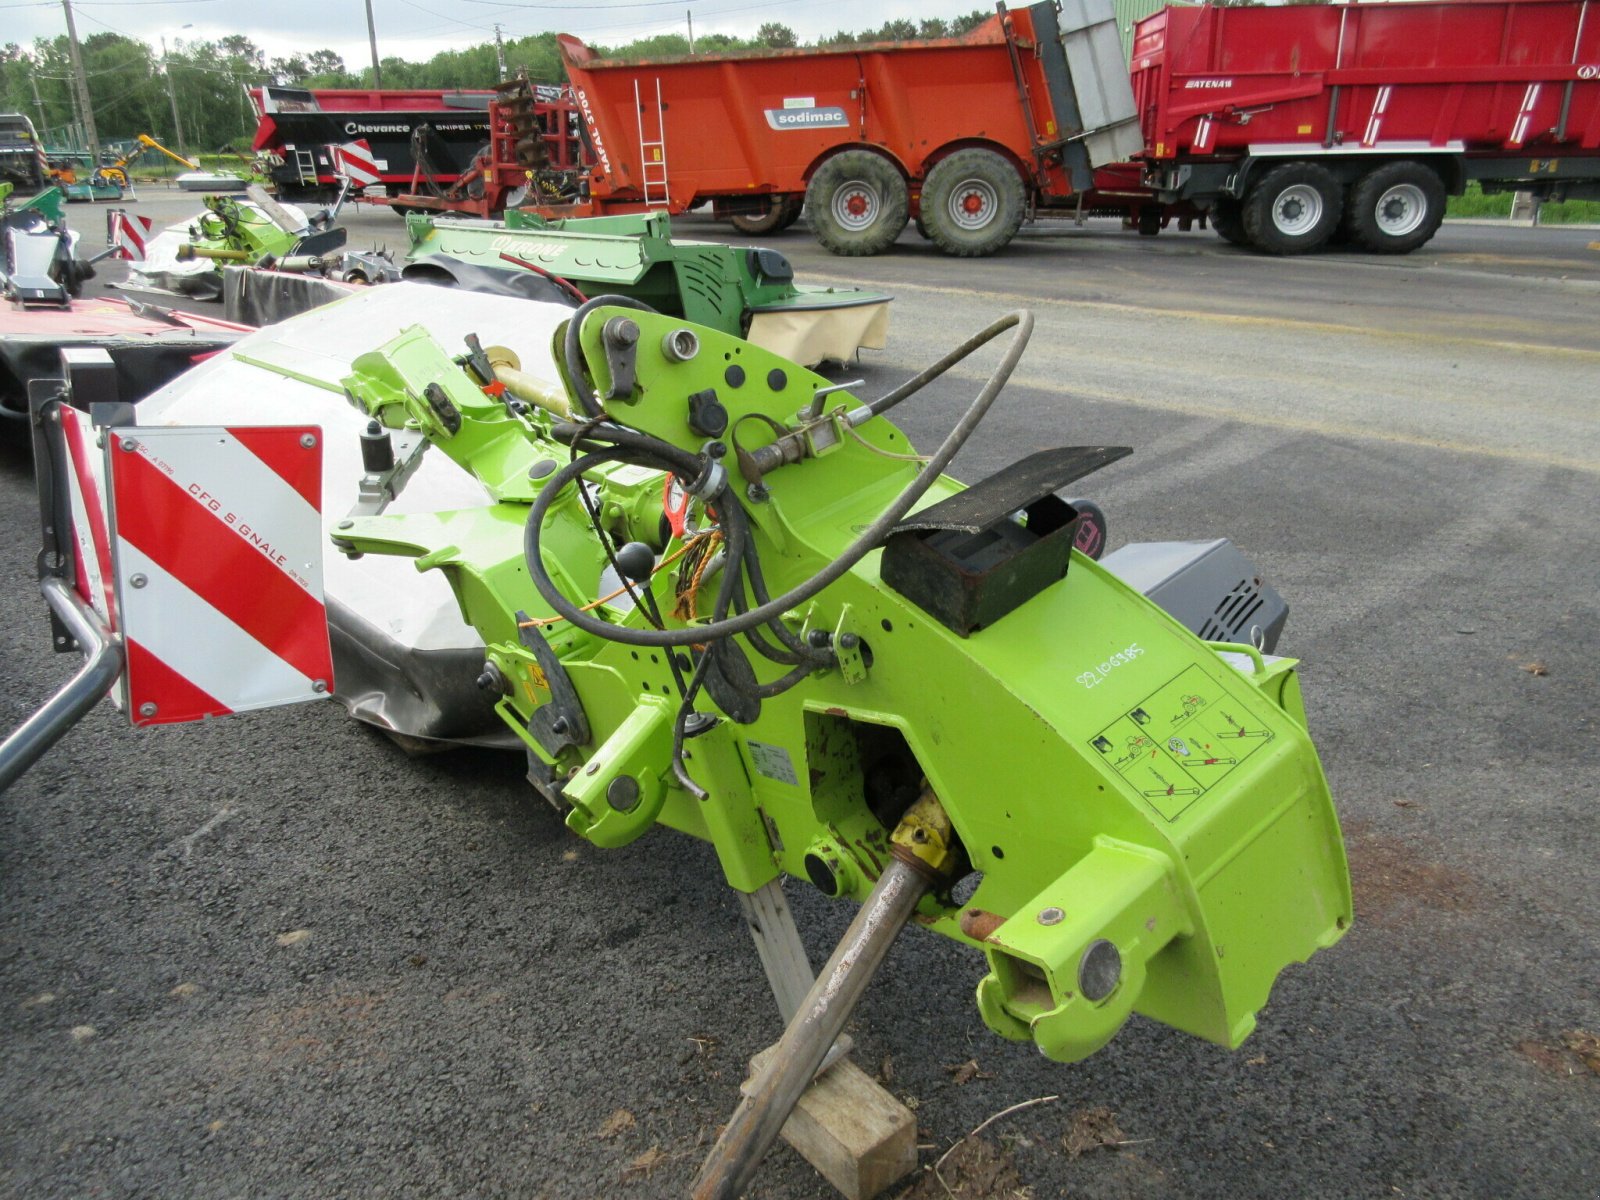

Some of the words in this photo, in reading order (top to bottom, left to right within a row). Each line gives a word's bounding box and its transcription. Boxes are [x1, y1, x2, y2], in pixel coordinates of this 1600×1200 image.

[578, 90, 595, 125] 3700
[778, 112, 842, 124] sodimac
[344, 122, 411, 135] Chevance
[592, 127, 611, 174] RAFAL
[188, 482, 221, 512] CFG
[224, 512, 287, 567] SGNALE
